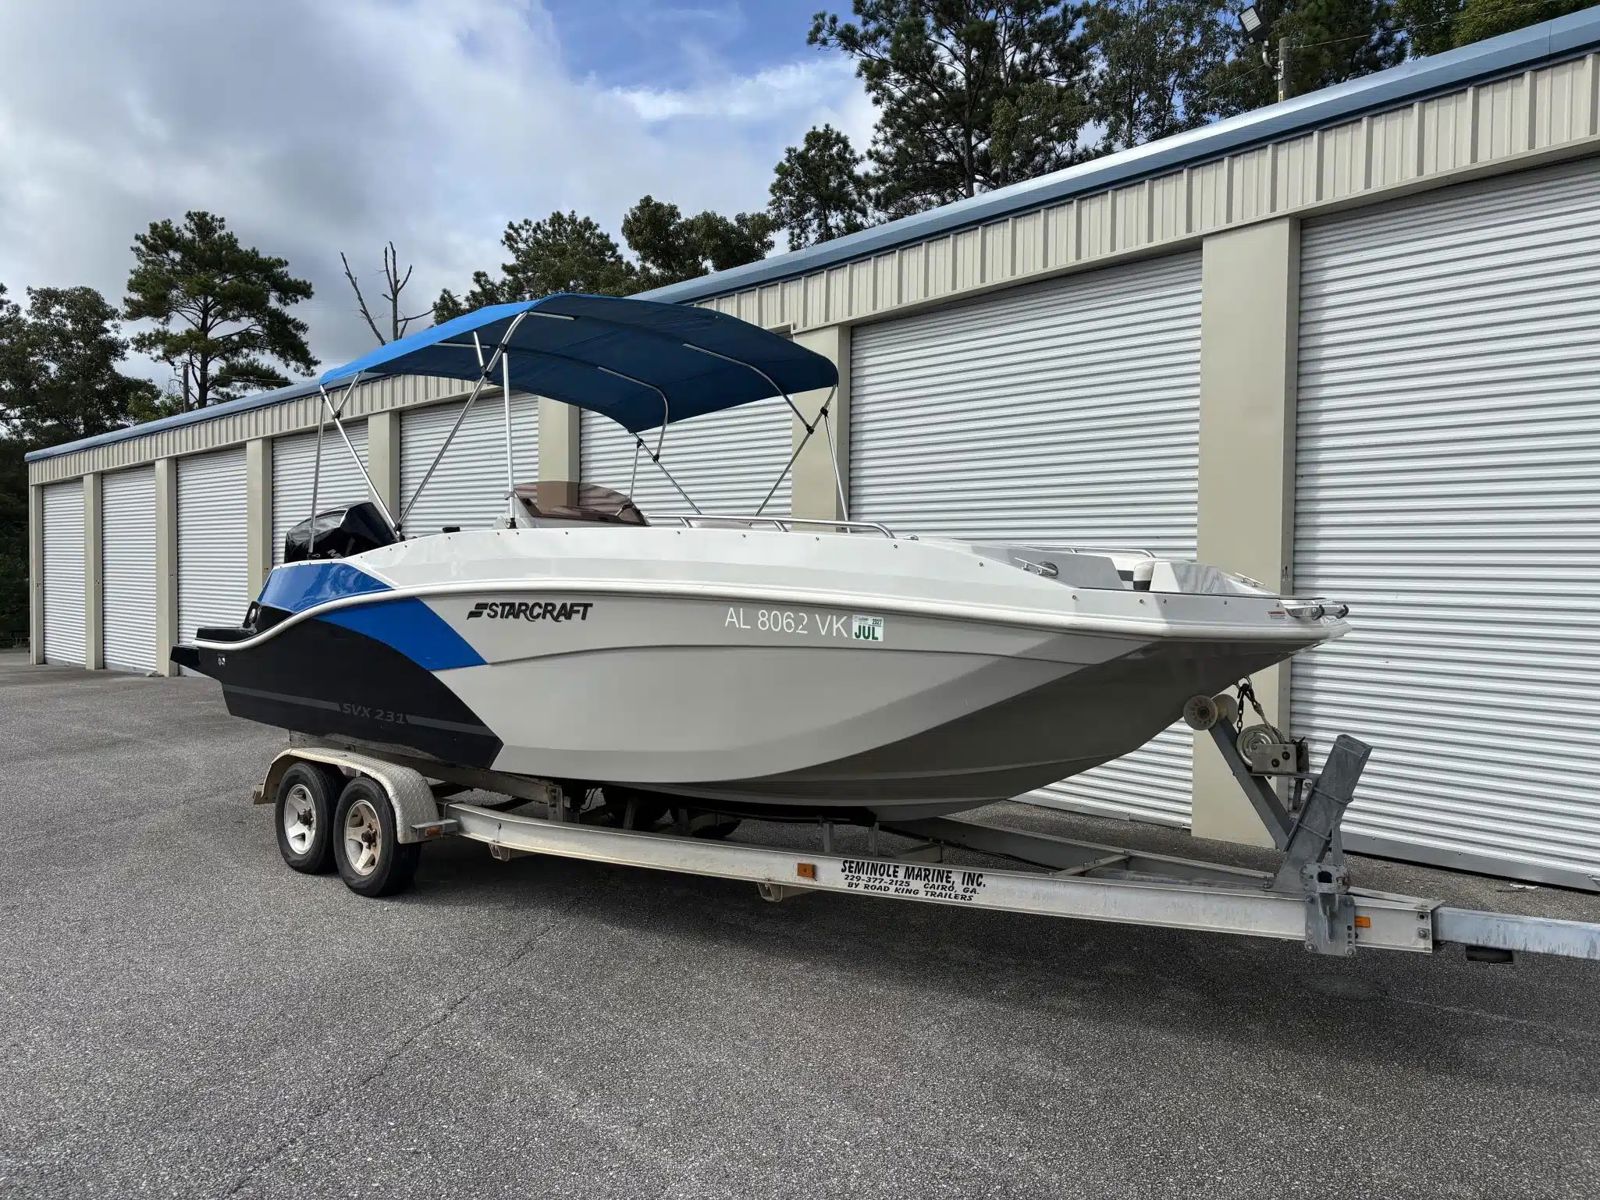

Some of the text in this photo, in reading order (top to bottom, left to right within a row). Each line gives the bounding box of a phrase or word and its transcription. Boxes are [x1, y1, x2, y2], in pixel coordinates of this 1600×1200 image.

[487, 602, 593, 622] STARCRAFT
[725, 607, 848, 638] AL 8062 VK
[854, 624, 879, 641] JUL
[342, 702, 405, 724] SVX 231
[840, 859, 986, 888] SEMINOLE MARINE, INC.
[844, 874, 911, 888] 229-377-2125
[962, 887, 980, 896] GA.
[847, 881, 974, 902] BY ROAD KING TRAILERS
